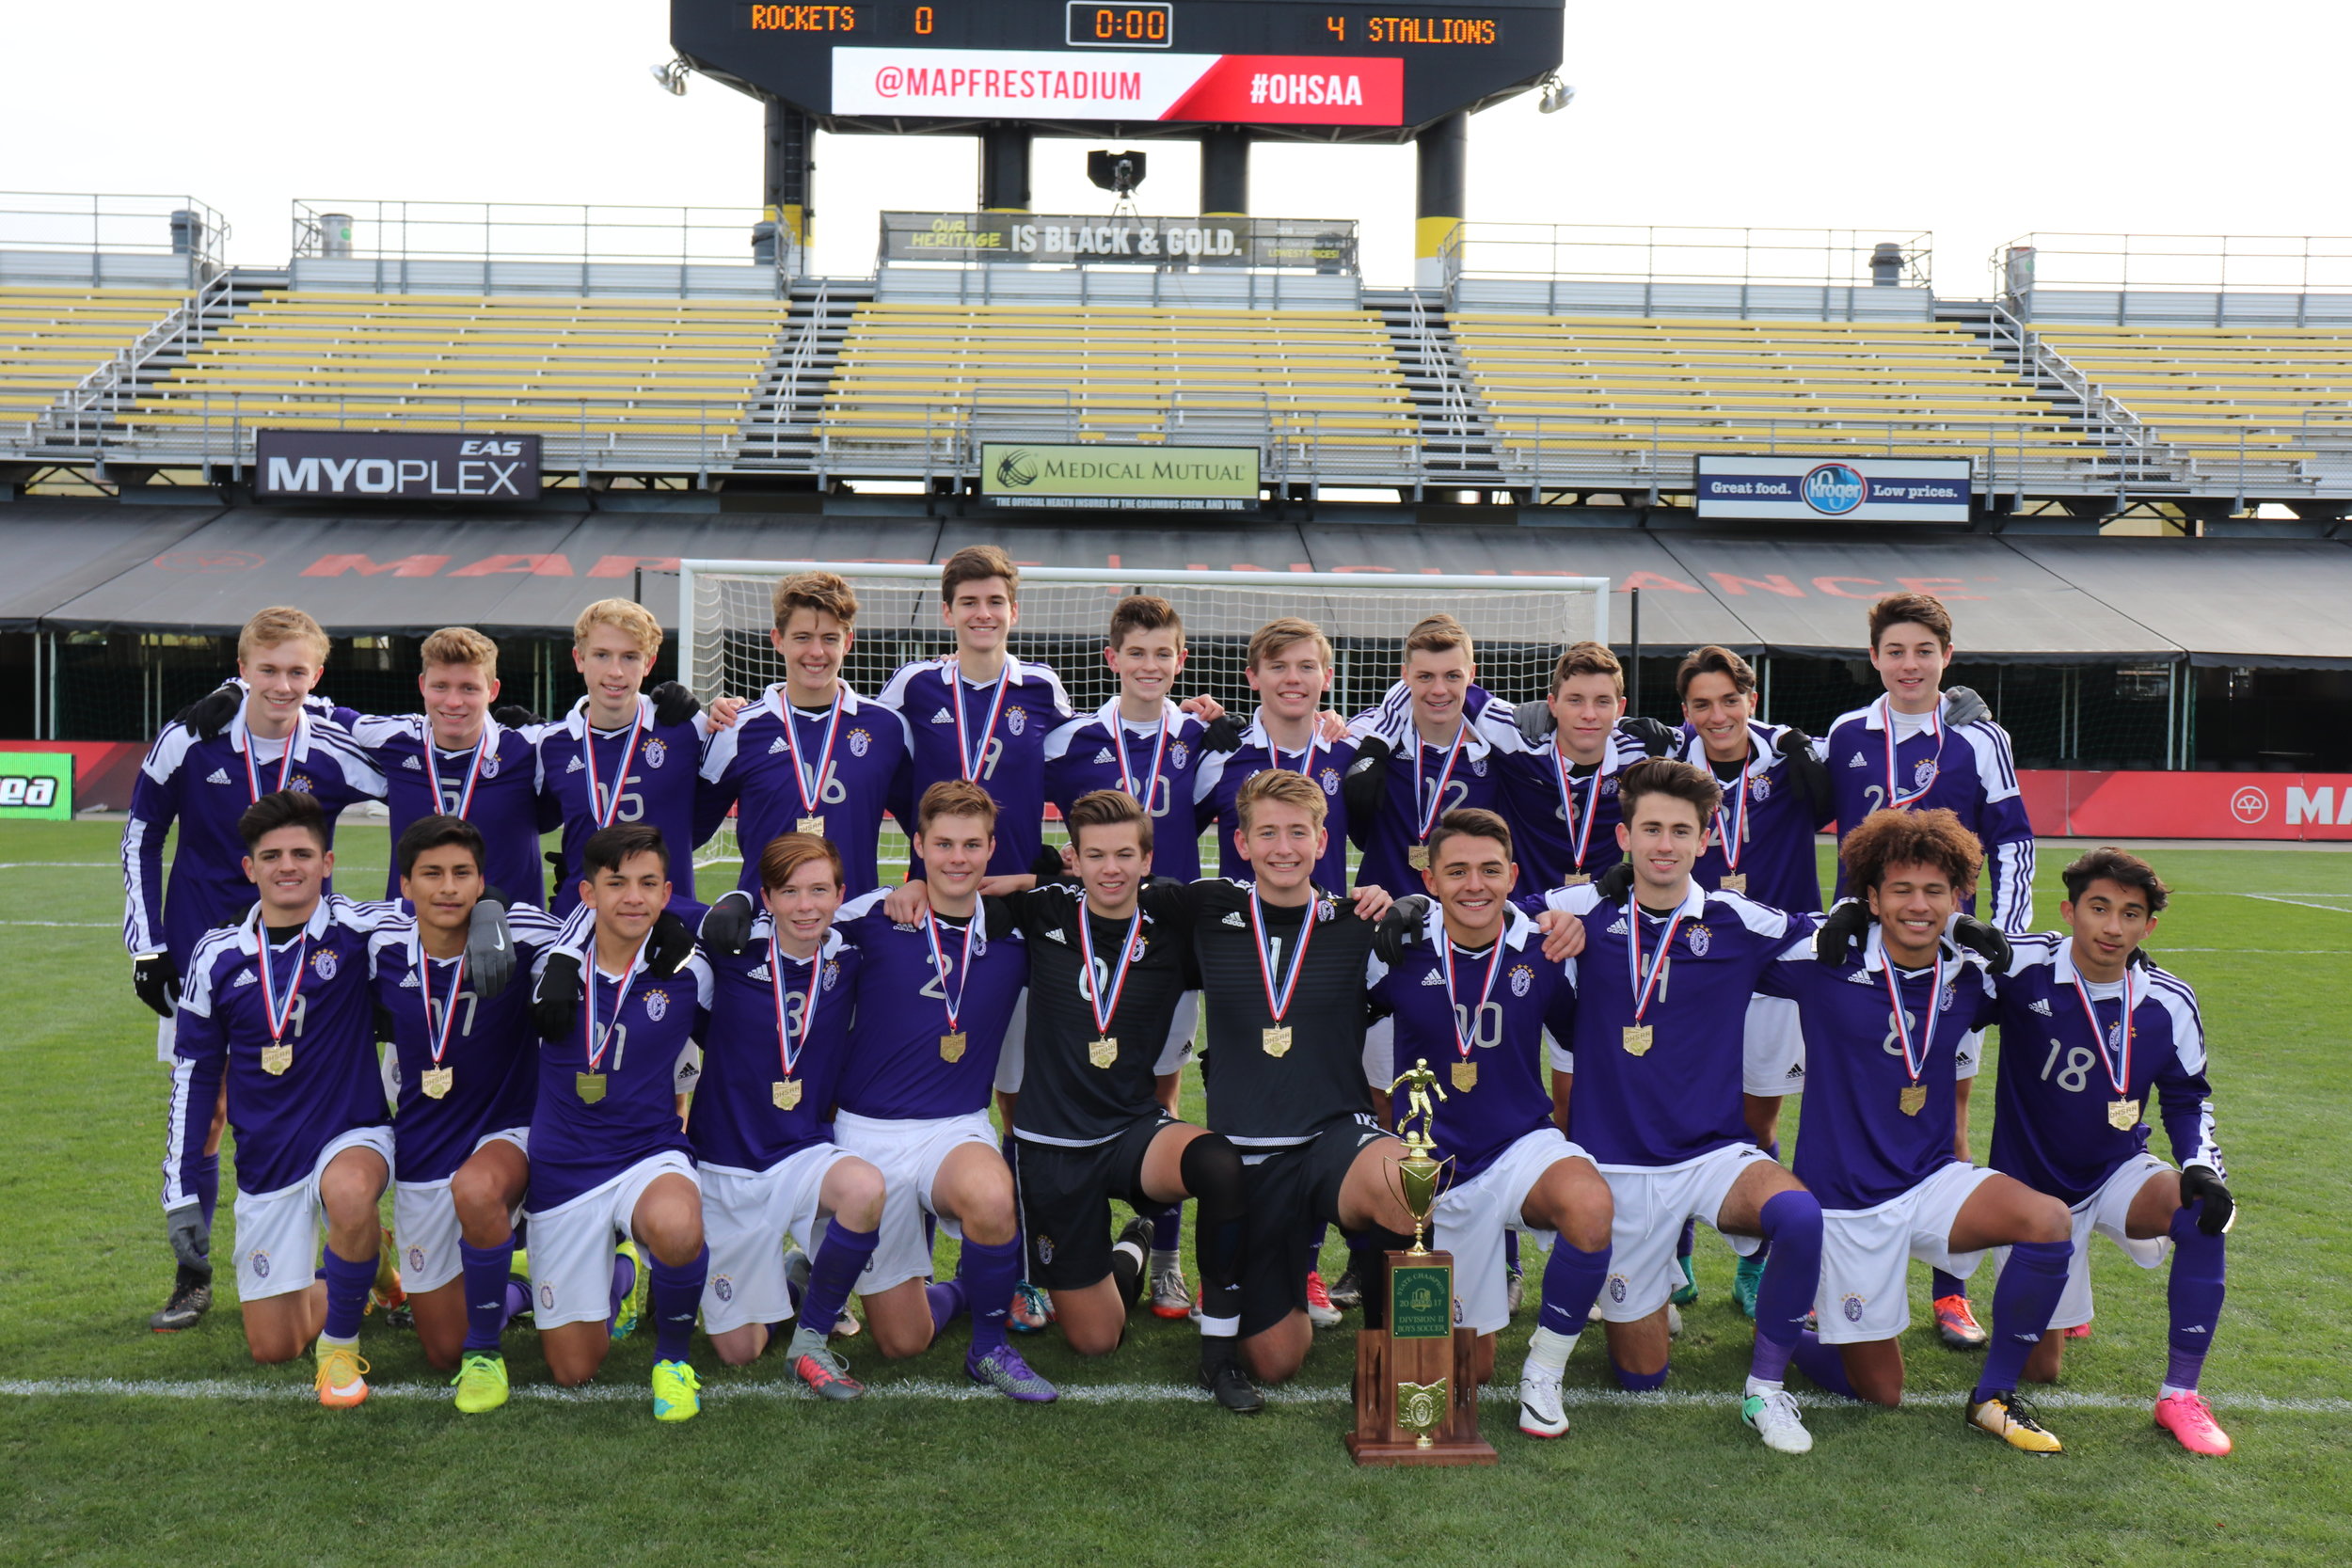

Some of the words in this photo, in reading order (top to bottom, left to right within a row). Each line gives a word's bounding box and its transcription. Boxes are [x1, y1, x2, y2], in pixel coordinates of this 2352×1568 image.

[752, 5, 855, 31] ROCKETS
[915, 6, 932, 35] 0
[1096, 9, 1165, 39] 0:00
[1327, 16, 1344, 40] 4
[1369, 17, 1496, 44] STALLIONS
[875, 66, 1141, 100] @MAPFRESTADIUM
[1250, 73, 1362, 105] #OHSAA
[912, 232, 1001, 247] HERITAGE
[1012, 225, 1037, 252] IS
[1044, 226, 1131, 254] BLACK
[1137, 227, 1159, 255] &
[1167, 228, 1242, 256] GOLD.
[460, 440, 522, 456] EAS
[268, 457, 519, 495] MYOPLEX
[1711, 482, 1752, 494] Great
[1756, 482, 1791, 495] food.
[996, 497, 1010, 507] THE
[1011, 497, 1045, 507] OFFICIAL
[1046, 498, 1073, 508] HEALTH
[1074, 498, 1108, 509] INSURER
[1110, 499, 1120, 509] OF
[1120, 499, 1135, 509] THE
[1136, 499, 1179, 509] COLUMBUS
[1206, 499, 1224, 510] AND
[1873, 484, 1906, 497] Low
[1908, 485, 1958, 499] prices.
[0, 776, 56, 806] ea
[206, 776, 231, 784] adidas
[1222, 918, 1246, 927] adidas
[747, 971, 772, 982] adidas
[919, 954, 953, 999] 2
[1079, 957, 1109, 1001] 0
[1848, 976, 1874, 986] adidas
[2028, 1004, 2053, 1017] adidas
[1883, 1009, 1916, 1055] 8
[2041, 1037, 2096, 1093] 18
[1397, 1276, 1412, 1295] STATE
[1413, 1273, 1446, 1294] CHAMPION
